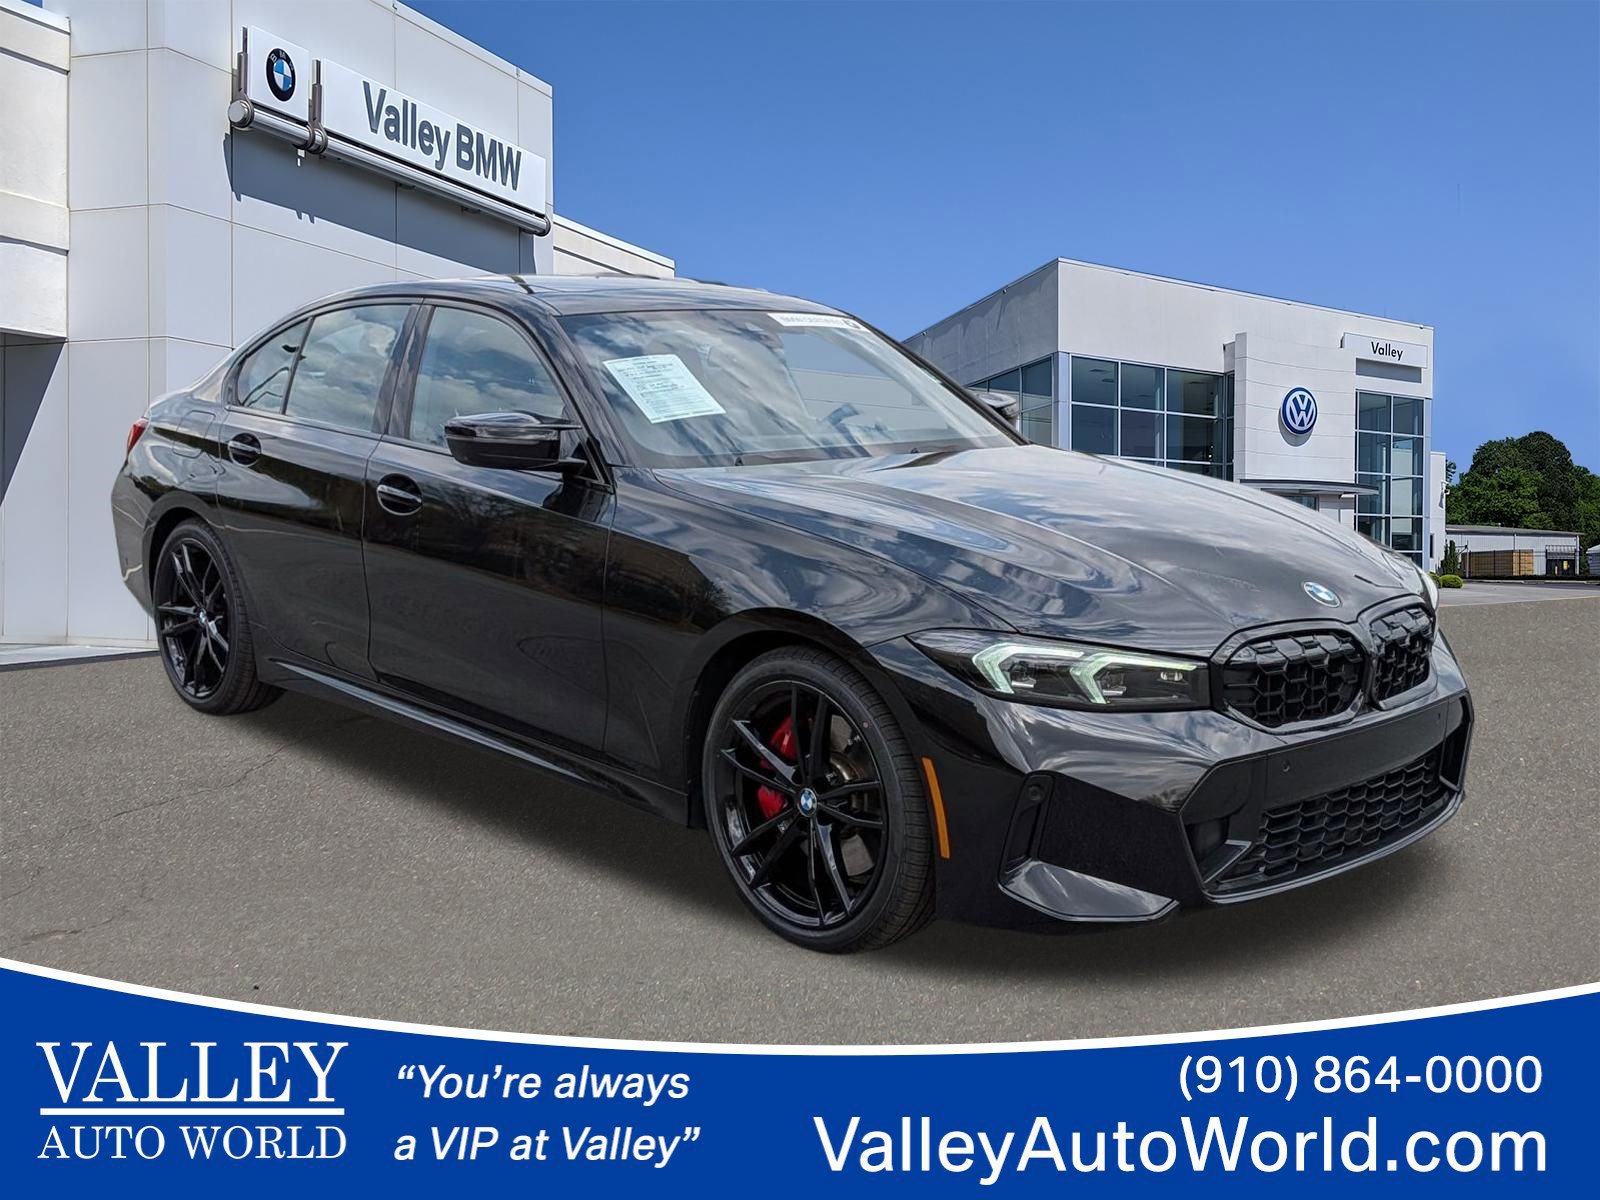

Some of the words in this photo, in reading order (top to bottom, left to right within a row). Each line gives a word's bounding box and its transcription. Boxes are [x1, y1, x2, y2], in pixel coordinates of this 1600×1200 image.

[362, 80, 450, 171] Valley
[456, 123, 522, 191] BMW
[1370, 341, 1404, 361] Valley
